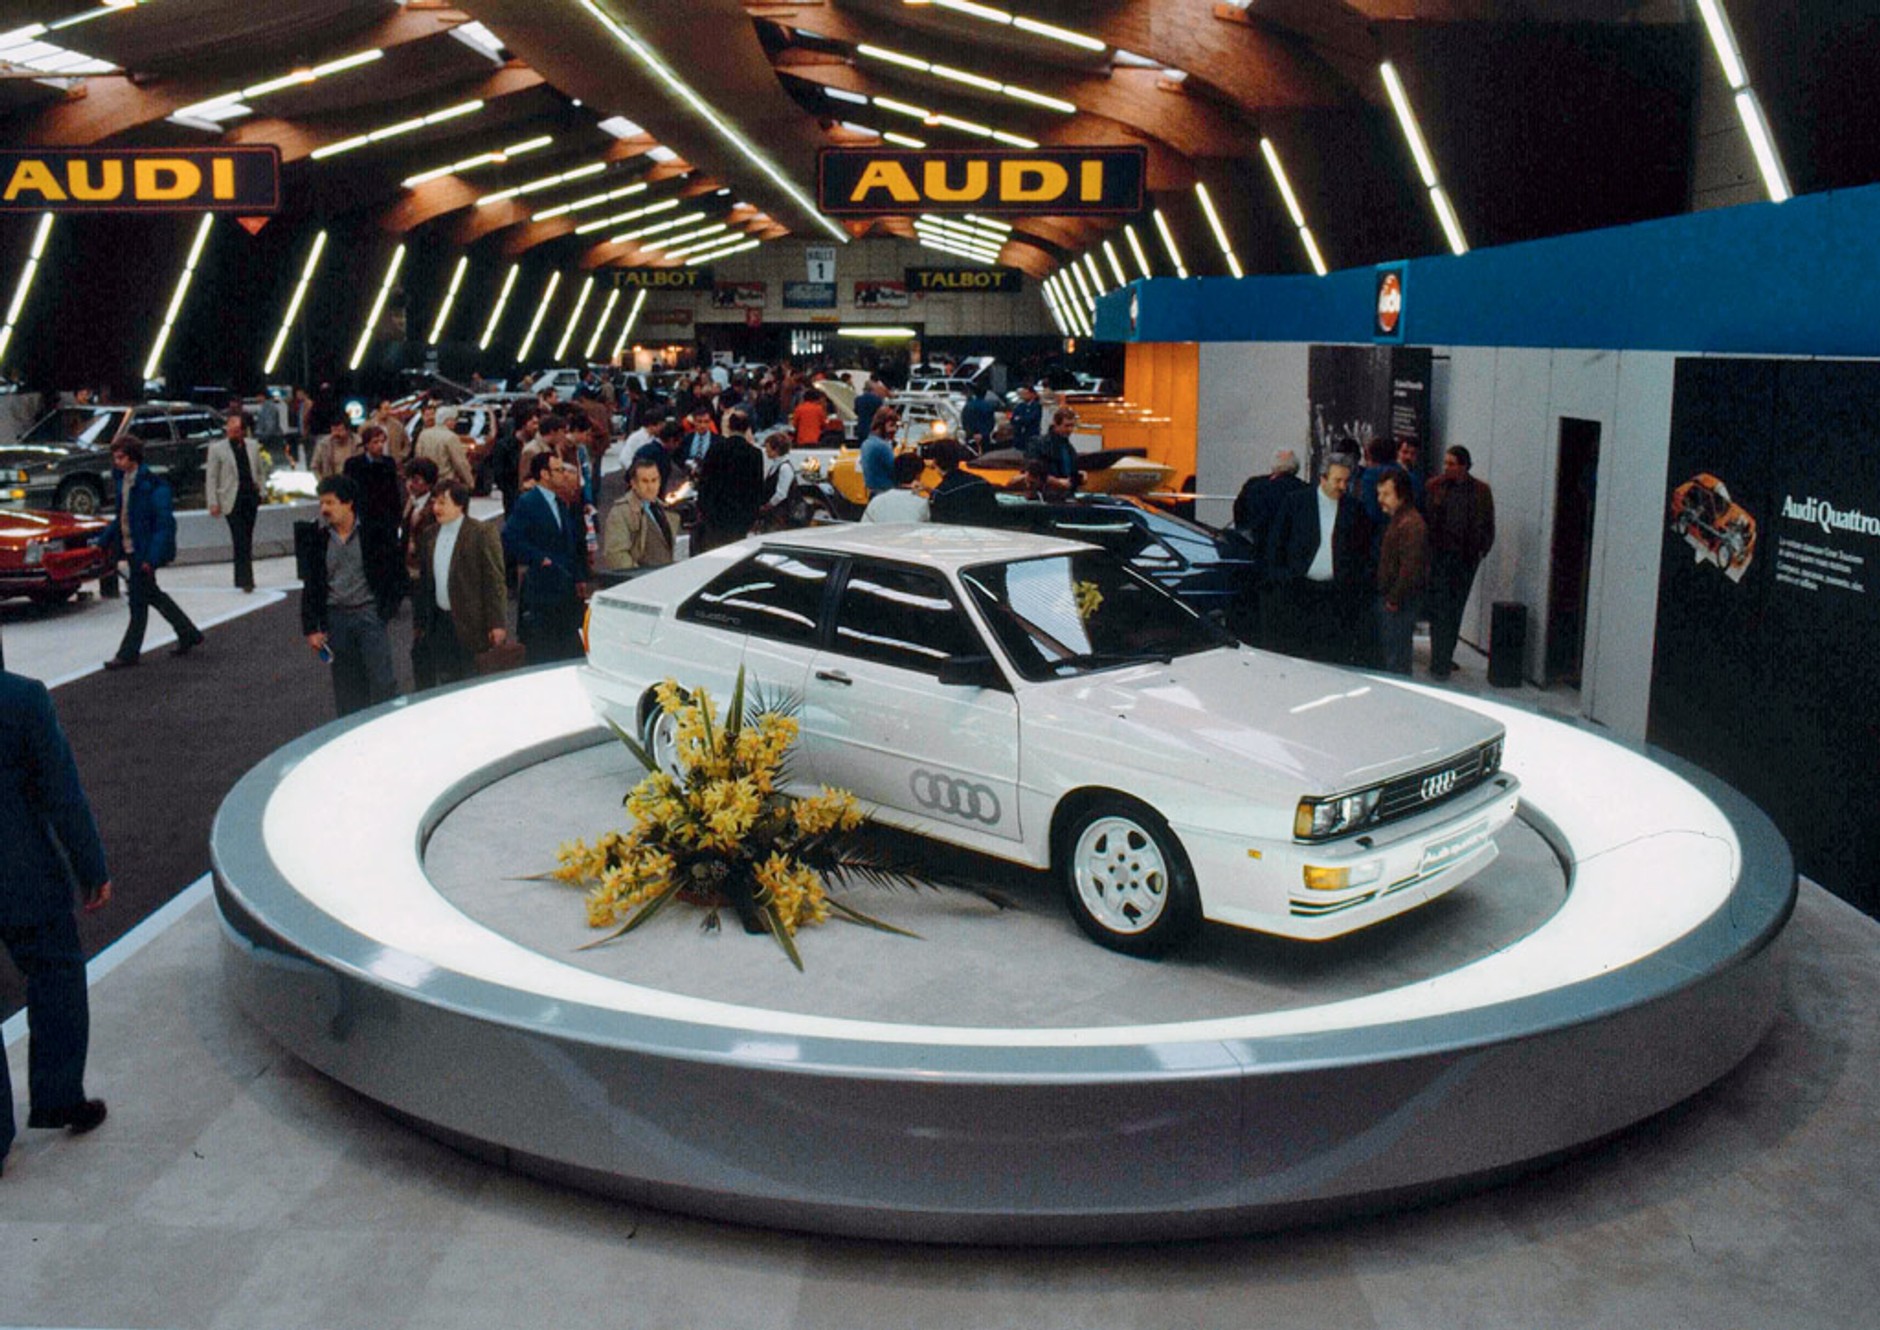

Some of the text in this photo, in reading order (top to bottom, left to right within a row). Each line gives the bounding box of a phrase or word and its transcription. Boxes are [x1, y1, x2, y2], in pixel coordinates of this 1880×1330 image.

[3, 158, 235, 200] AUDI
[850, 160, 1103, 201] AUDI
[610, 271, 699, 286] TALBOT
[817, 262, 824, 279] 1
[919, 271, 1007, 287] TALBOT
